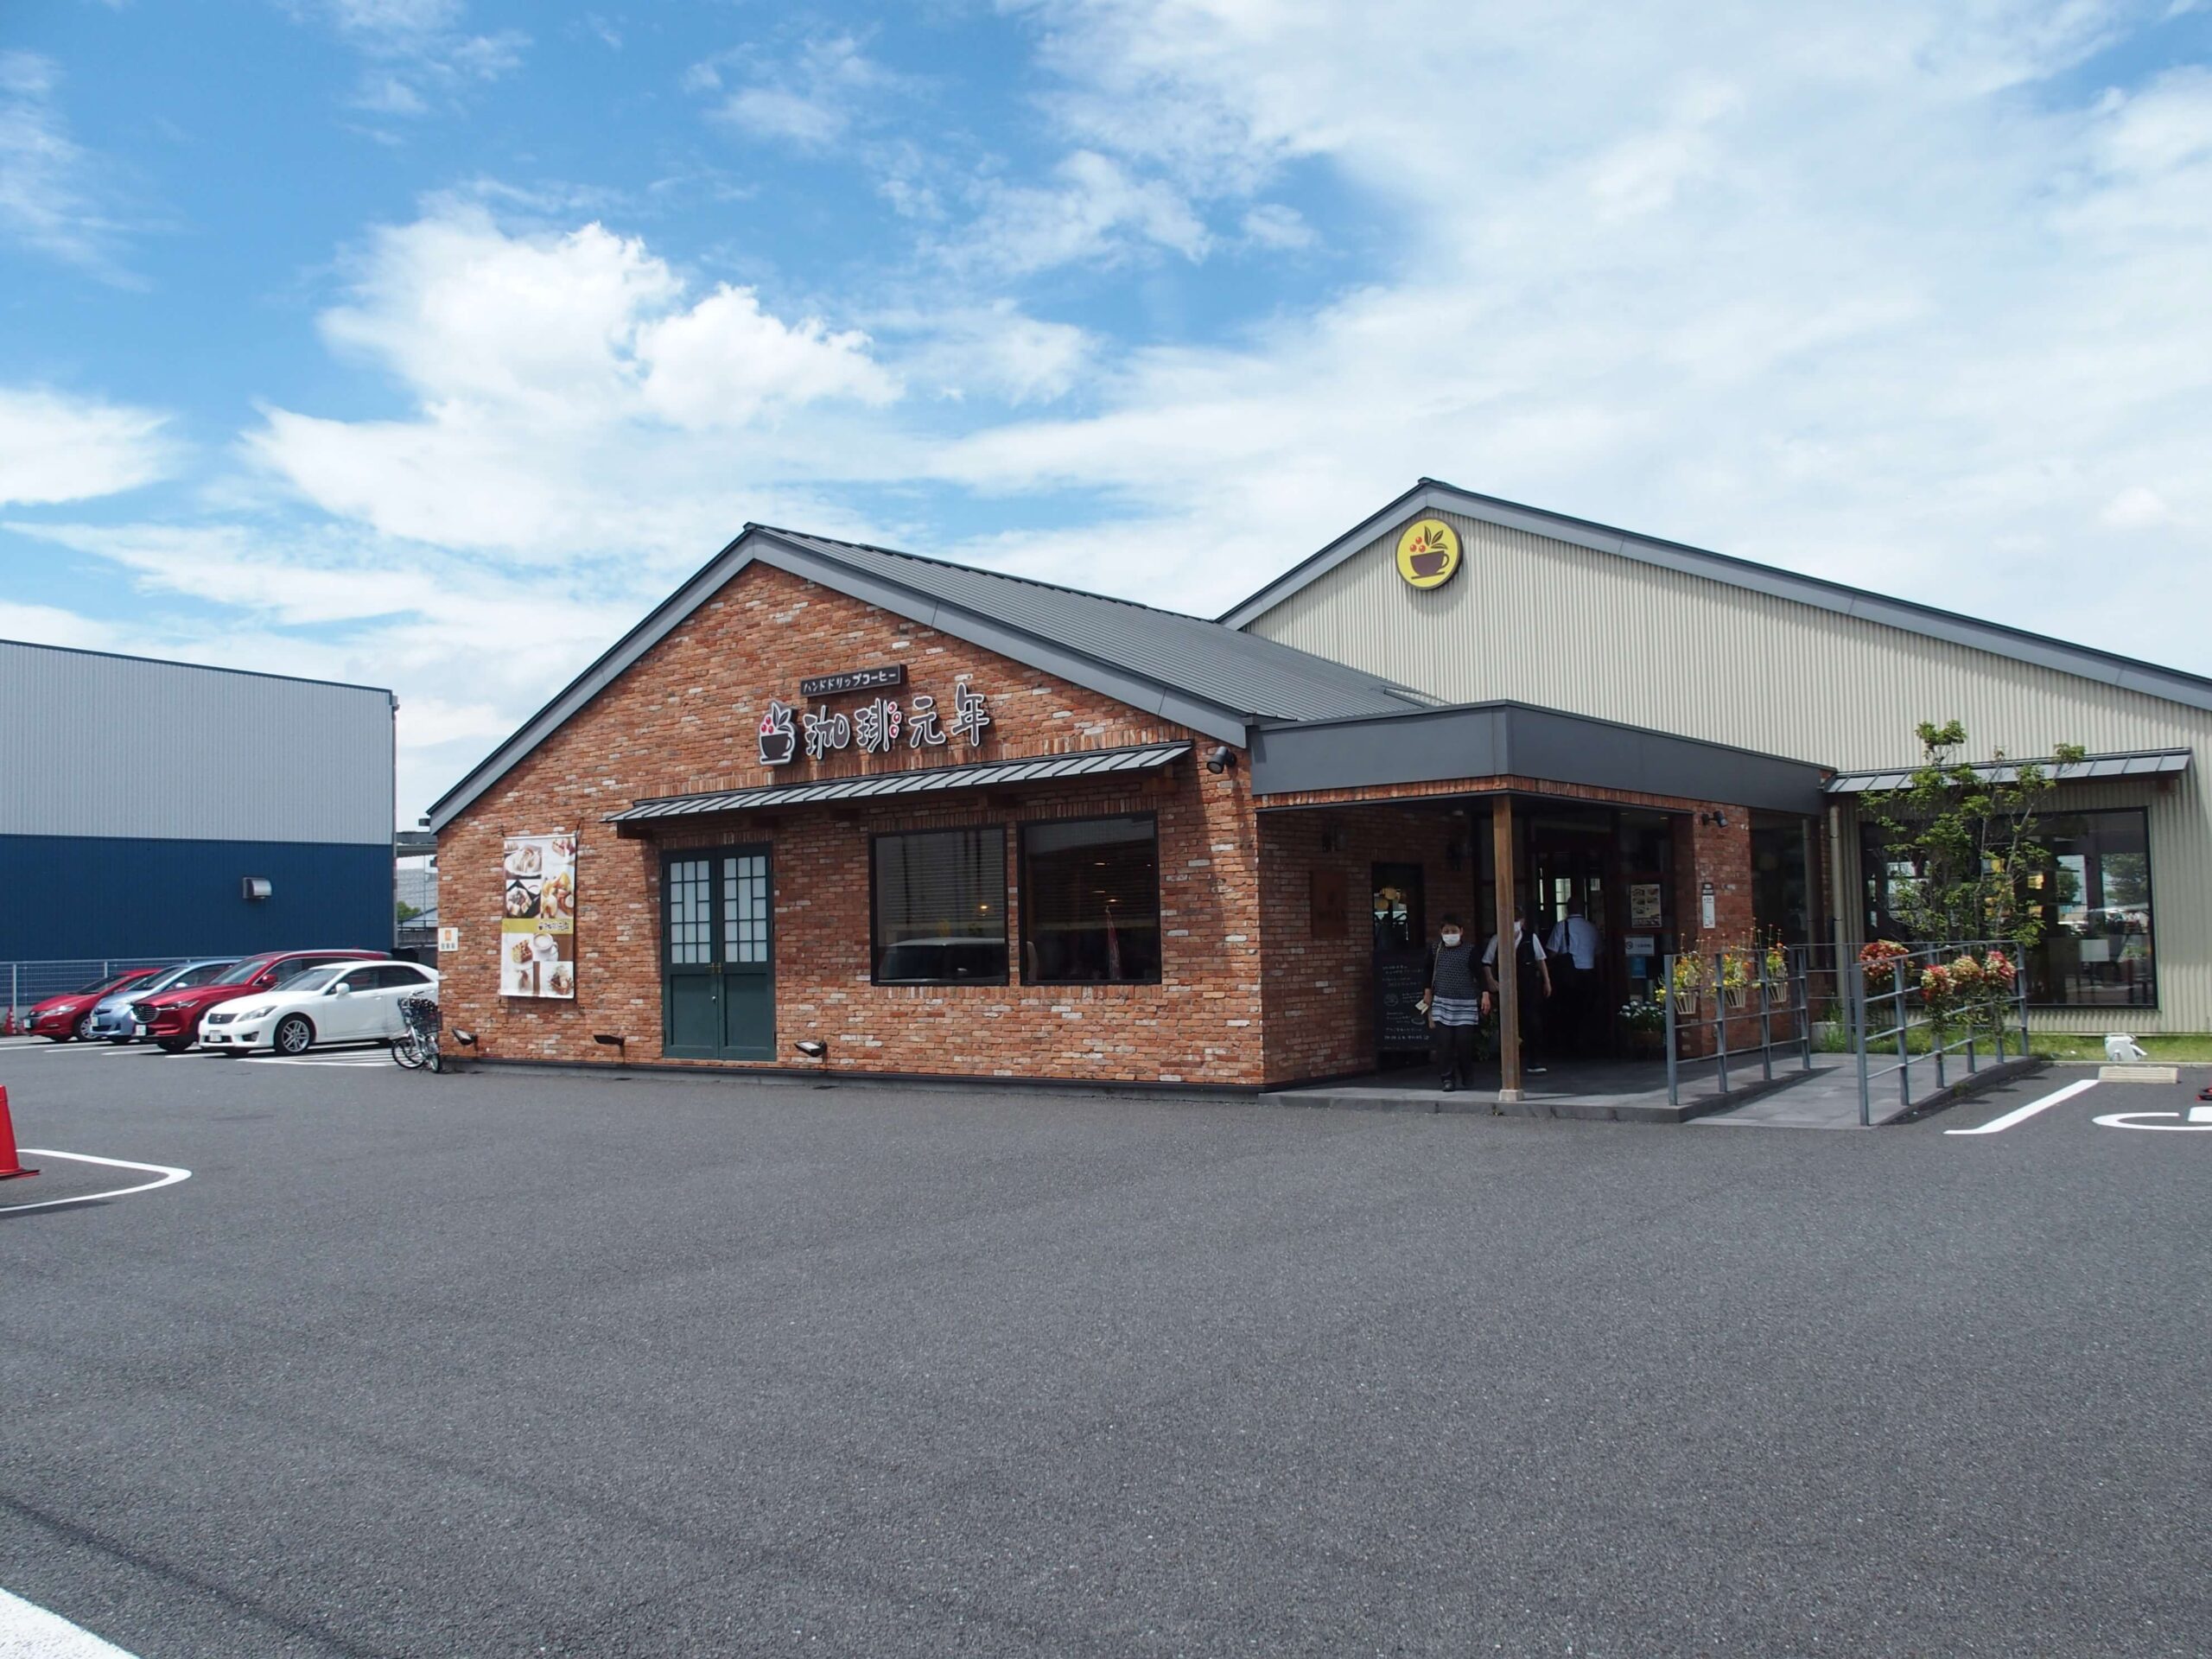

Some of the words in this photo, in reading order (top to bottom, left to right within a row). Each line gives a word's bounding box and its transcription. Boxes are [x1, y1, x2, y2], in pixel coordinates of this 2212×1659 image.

[803, 671, 897, 693] ハンドドリップコーヒー
[803, 682, 990, 760] 珈琲元年
